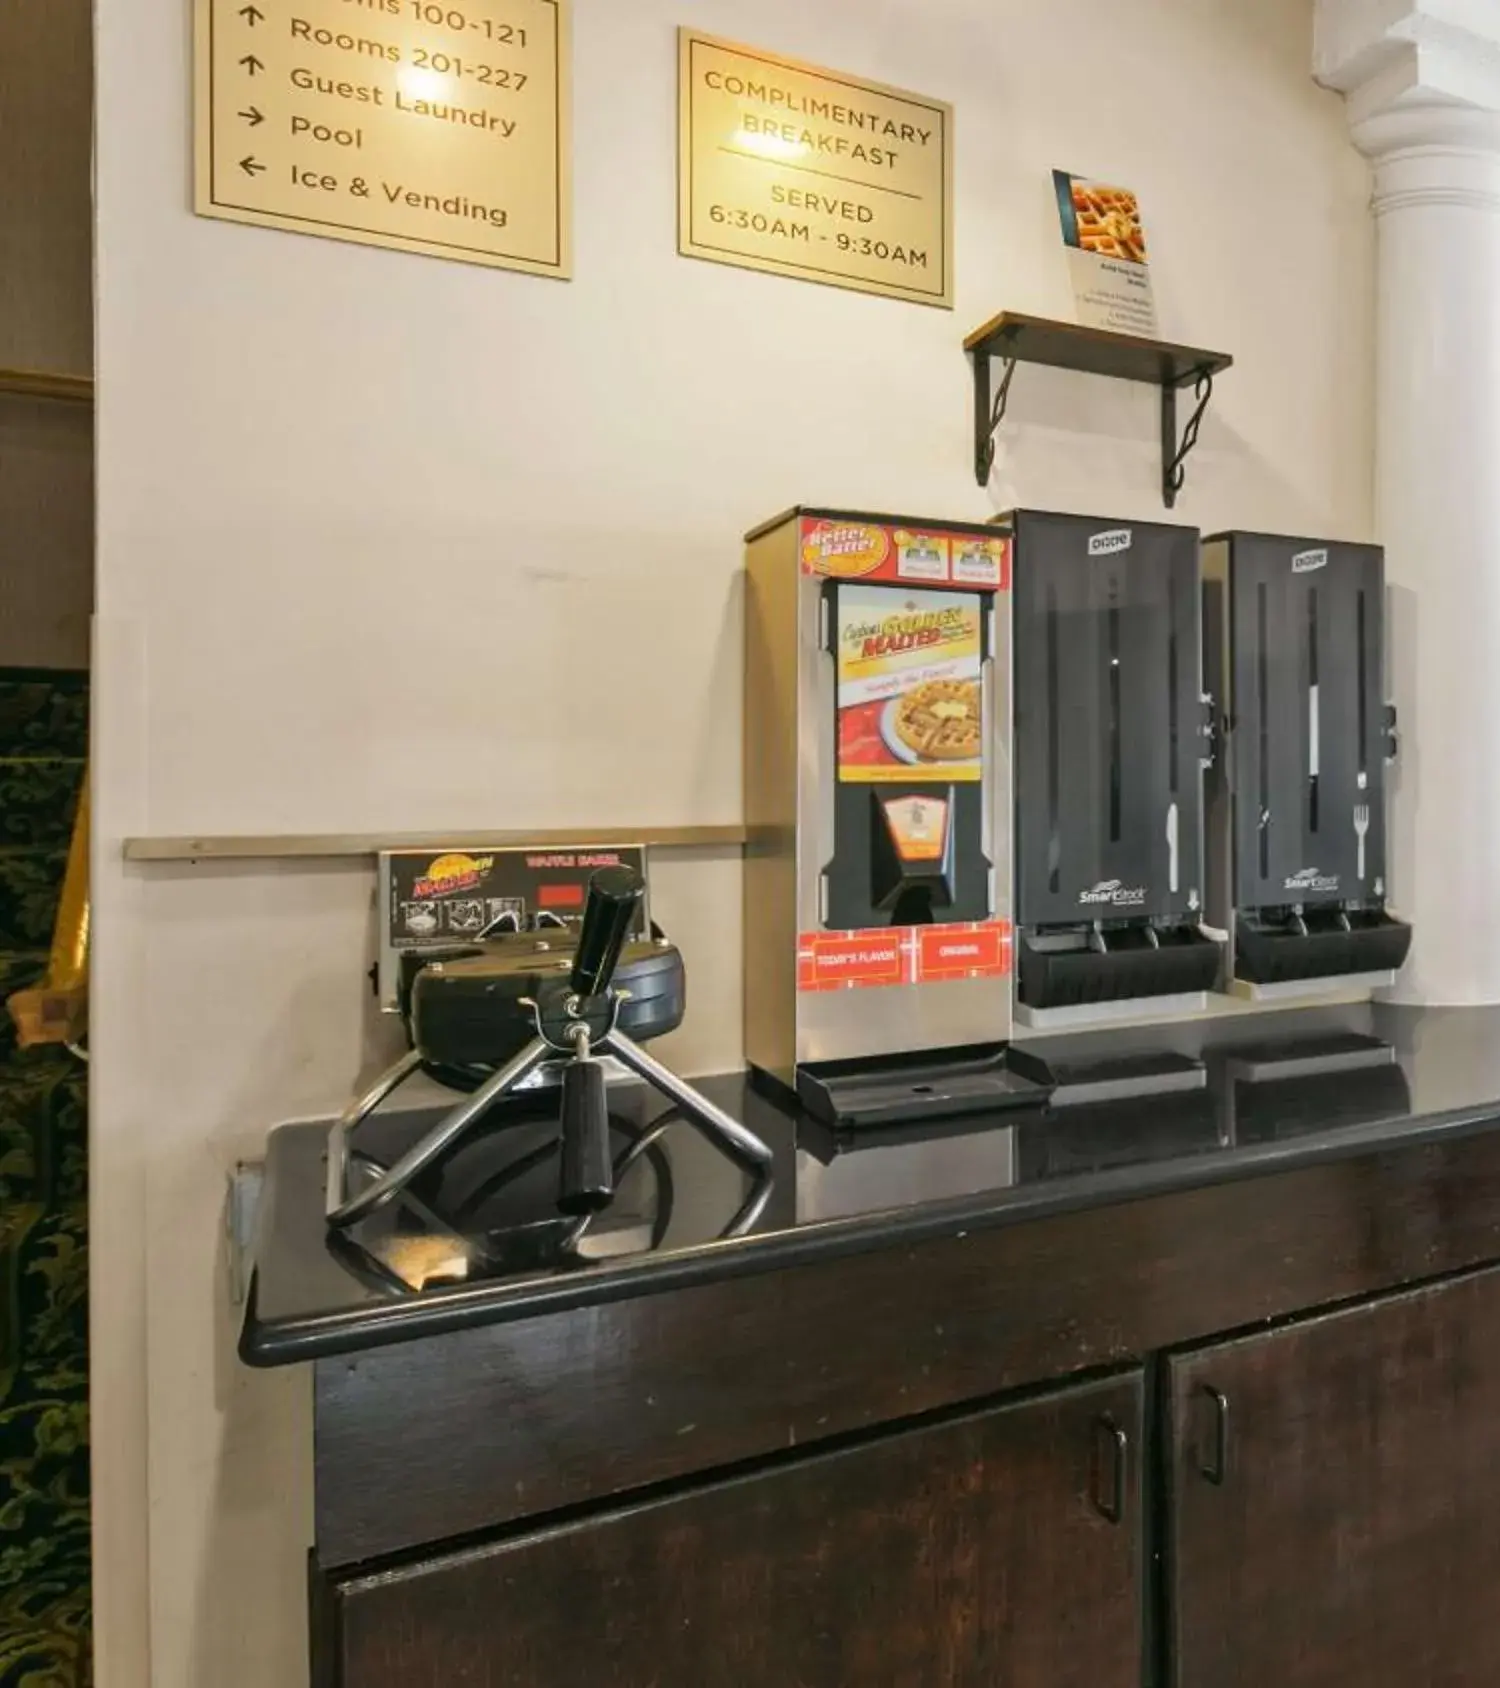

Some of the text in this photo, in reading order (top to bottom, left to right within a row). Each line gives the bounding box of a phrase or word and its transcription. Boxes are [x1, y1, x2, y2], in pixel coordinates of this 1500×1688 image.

[290, 17, 529, 93] Rooms 201-227
[410, 1, 528, 48] 100-121
[290, 68, 517, 138] Guest Laundry
[291, 115, 363, 149] Pool
[704, 70, 932, 147] COMPLIMENTARY
[741, 113, 899, 170] BREAKFAST
[291, 165, 509, 228] Ice & Vending
[771, 184, 874, 224] SERVED
[709, 204, 811, 242] 6:30AM
[836, 232, 928, 269] 9:30AM
